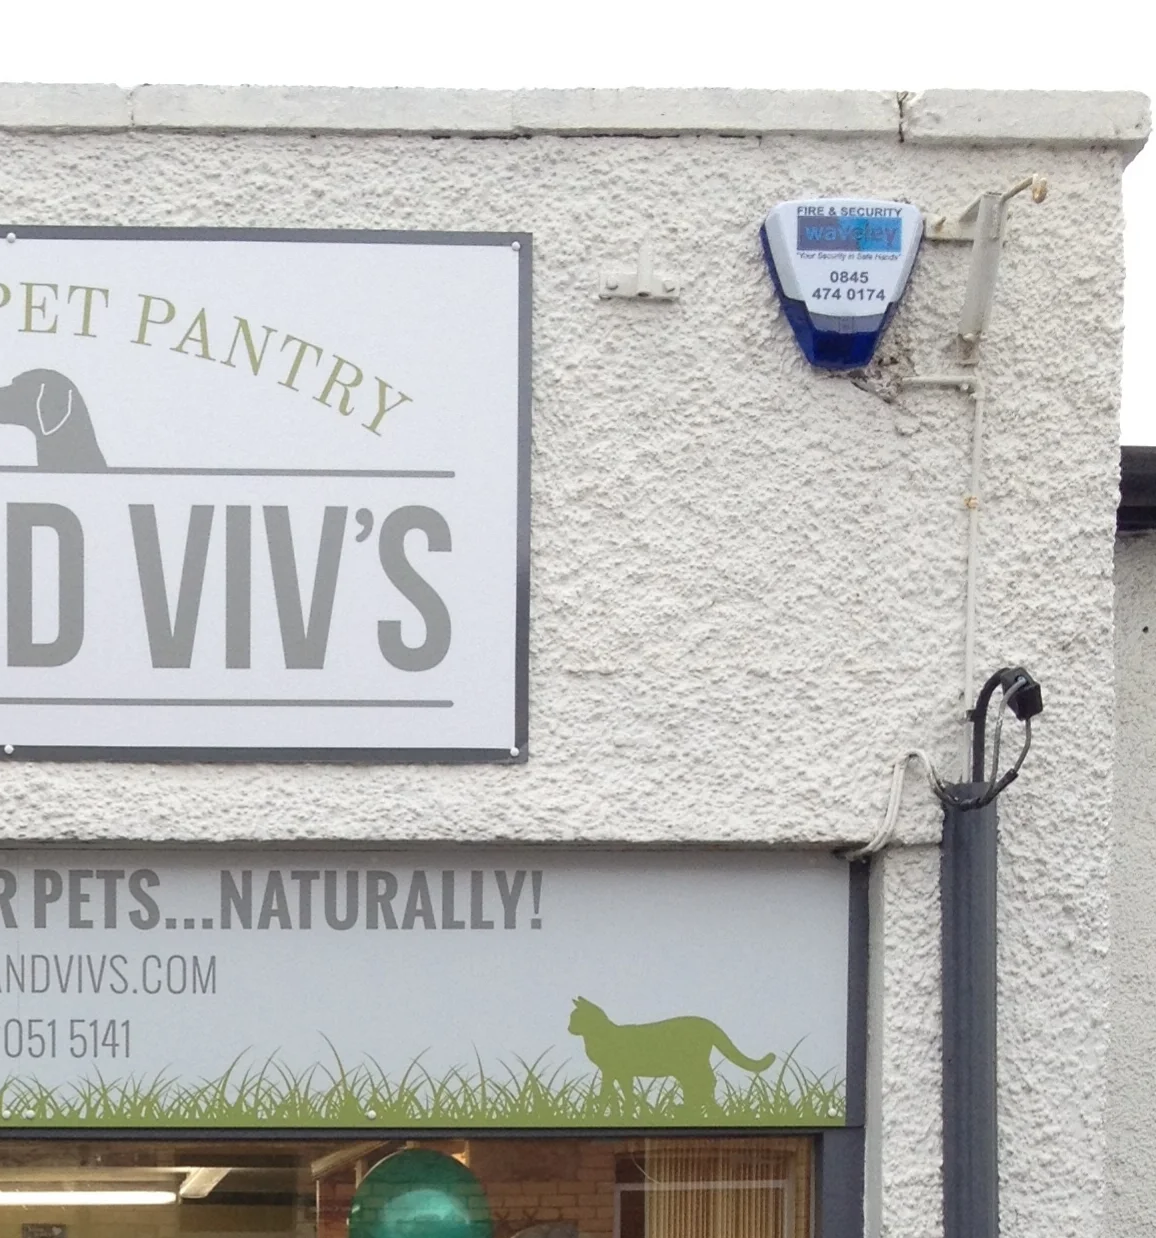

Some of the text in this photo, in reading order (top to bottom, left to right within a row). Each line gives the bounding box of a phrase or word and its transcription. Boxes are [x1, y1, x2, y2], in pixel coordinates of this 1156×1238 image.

[797, 207, 902, 217] FIRE & SECURITY
[830, 271, 869, 284] 0845
[812, 287, 886, 301] 474 0174
[130, 293, 414, 437] PANTRY
[128, 503, 452, 673] VIV'S
[70, 1019, 131, 1059] 5141
